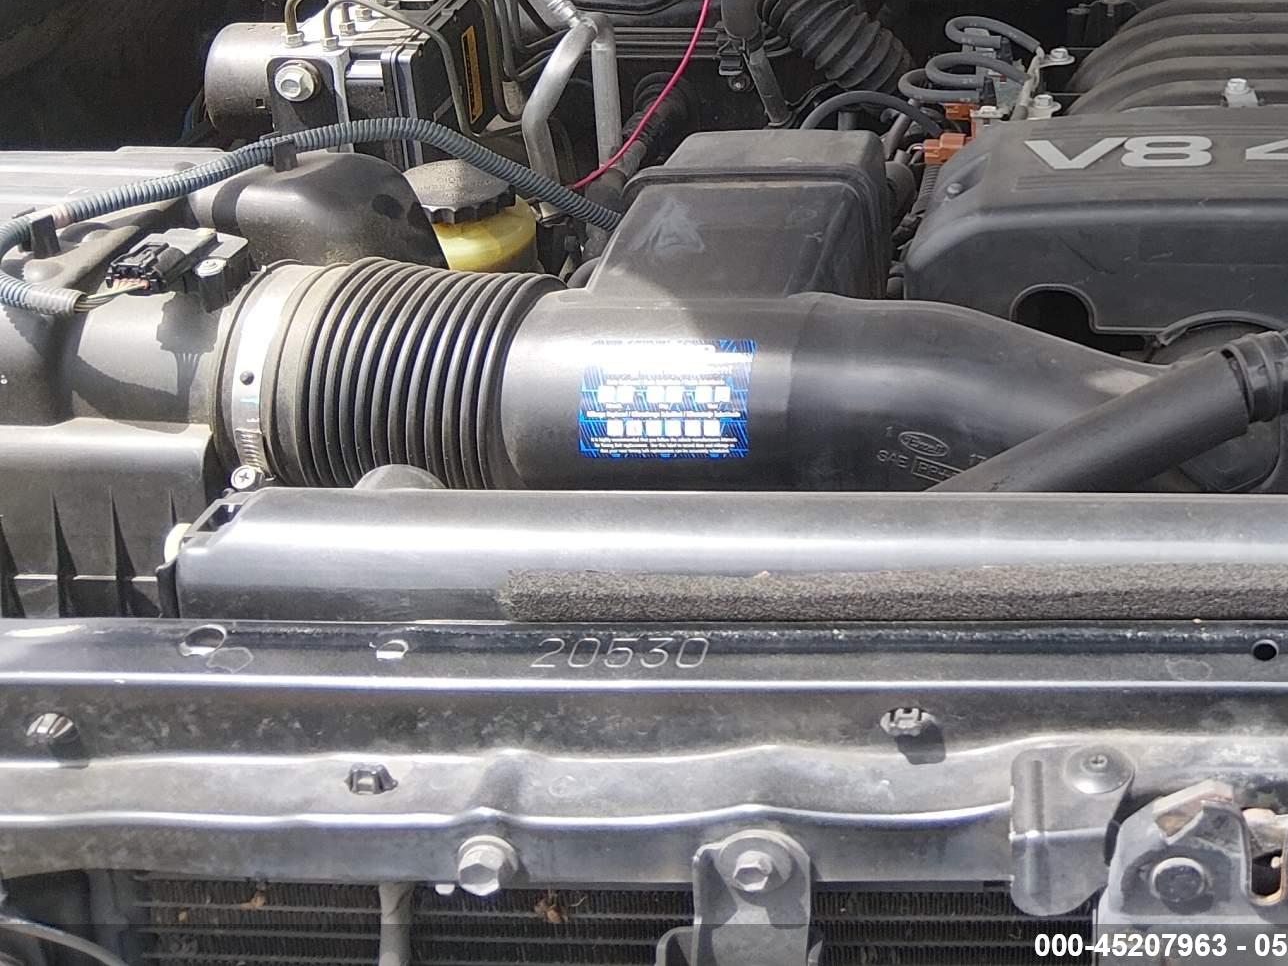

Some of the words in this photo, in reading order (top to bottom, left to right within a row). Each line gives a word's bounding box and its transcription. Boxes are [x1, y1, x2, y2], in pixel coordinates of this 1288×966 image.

[1024, 135, 1213, 170] V8
[876, 449, 910, 469] SAE
[530, 636, 711, 669] 20530
